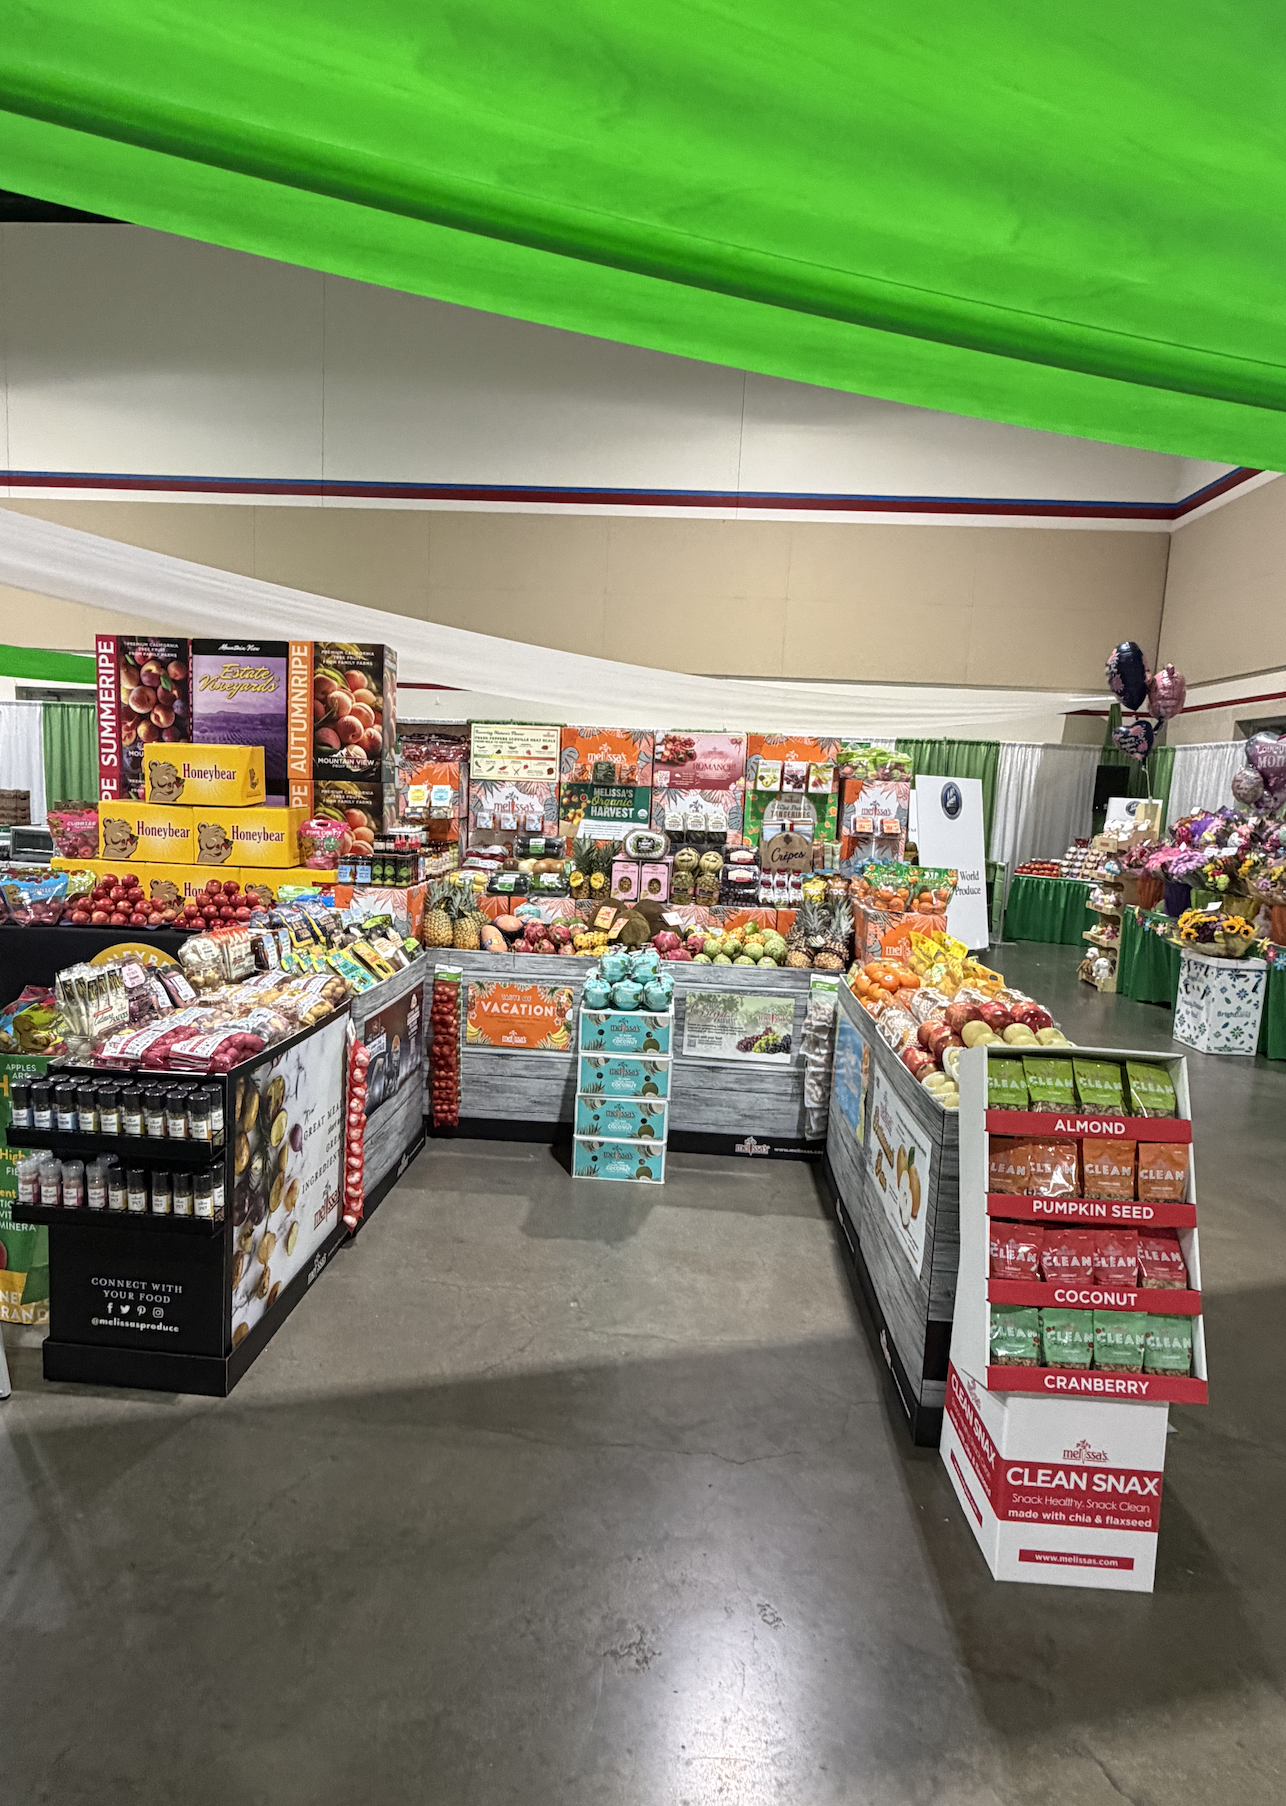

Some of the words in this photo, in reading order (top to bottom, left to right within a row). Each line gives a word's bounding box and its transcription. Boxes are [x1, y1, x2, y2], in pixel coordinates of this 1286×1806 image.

[220, 663, 272, 680] Estate
[199, 674, 279, 700] Vineyards
[98, 641, 117, 767] SUMMERIPE
[290, 645, 308, 773] AUTUMNRIPE
[317, 757, 354, 765] MOUNTAIN
[182, 763, 237, 782] Honeybear
[593, 787, 634, 798] MELISSA'S
[494, 800, 535, 812] melissa's
[591, 795, 633, 808] Organic
[590, 806, 635, 818] HARVEST
[861, 807, 892, 816] melissa's
[136, 820, 190, 840] Honeybear
[231, 825, 285, 843] Honeybear
[959, 870, 979, 882] World
[184, 882, 205, 897] Hon
[955, 885, 981, 896] Produce
[481, 1000, 554, 1017] VACATION
[5, 1063, 37, 1072] APPLES
[1028, 1075, 1073, 1088] CLEAN
[1079, 1077, 1123, 1090] CLEAN
[1132, 1080, 1175, 1094] CLEAN
[303, 1115, 325, 1141] GREAT
[1054, 1118, 1126, 1135] ALMOND
[302, 1149, 340, 1195] INGREDIENT
[990, 1162, 1026, 1176] LEAN
[1084, 1163, 1132, 1177] CLEAN
[1139, 1169, 1184, 1180] CLEAN
[1032, 1200, 1106, 1217] PUMPKIN
[1112, 1205, 1154, 1219] SEED
[0, 1221, 37, 1233] MINERA
[990, 1246, 1037, 1263] CLEAN
[1042, 1256, 1092, 1267] CLEAN
[1137, 1249, 1181, 1262] CLEAN
[91, 1277, 148, 1290] CONNECT
[151, 1282, 183, 1294] WITH
[103, 1290, 135, 1301] YOUR
[139, 1293, 171, 1304] FOOD
[1054, 1288, 1138, 1306] COCONUT
[1, 1304, 49, 1322] RAND
[91, 1317, 179, 1332] @melissasproduce
[1046, 1330, 1093, 1343] CLEAN
[1096, 1332, 1144, 1345] CLEAN
[1145, 1335, 1191, 1348] CLEAN
[1043, 1374, 1150, 1396] CRANBERRY
[951, 1373, 974, 1427] CLEAN
[972, 1416, 996, 1471] SNAX
[1062, 1449, 1109, 1463] melissa's
[1006, 1466, 1088, 1491] CLEAN
[1092, 1473, 1160, 1497] SNAX
[1012, 1493, 1043, 1505] Snack
[1045, 1495, 1085, 1510] Healthy.
[1086, 1498, 1117, 1511] Snack
[1119, 1501, 1150, 1513] Clean
[1008, 1508, 1039, 1519] made
[1042, 1511, 1066, 1521] with
[1068, 1513, 1092, 1524] chia
[1094, 1515, 1102, 1524] &
[1105, 1515, 1152, 1528] flaxseed
[1035, 1553, 1119, 1567] www.melissas.com
